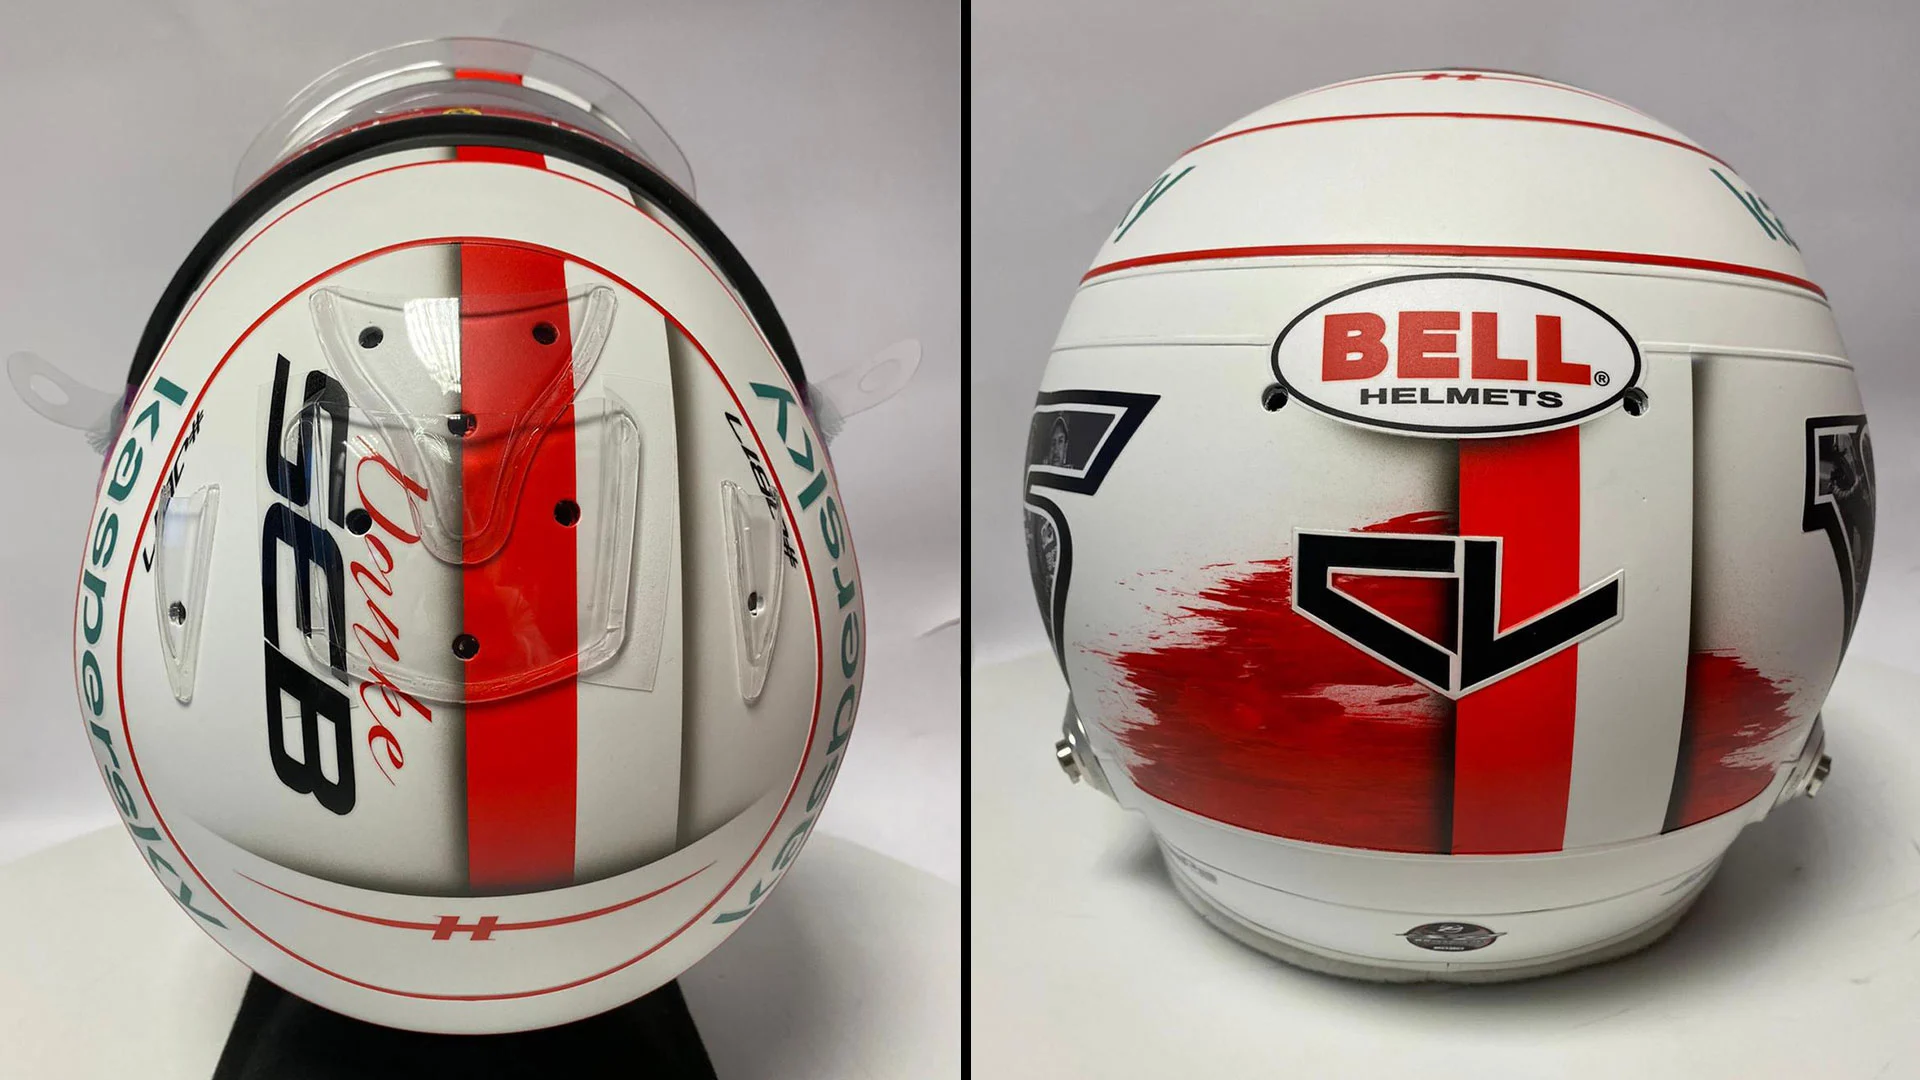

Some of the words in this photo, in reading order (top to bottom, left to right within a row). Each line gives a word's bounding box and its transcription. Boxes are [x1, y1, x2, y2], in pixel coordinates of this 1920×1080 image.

[1322, 311, 1591, 385] BELL
[1360, 387, 1563, 408] HELMETS
[80, 376, 229, 930] kaspersky
[261, 353, 356, 815] SEB
[350, 435, 432, 786] Danke
[712, 381, 862, 925] kaspersky
